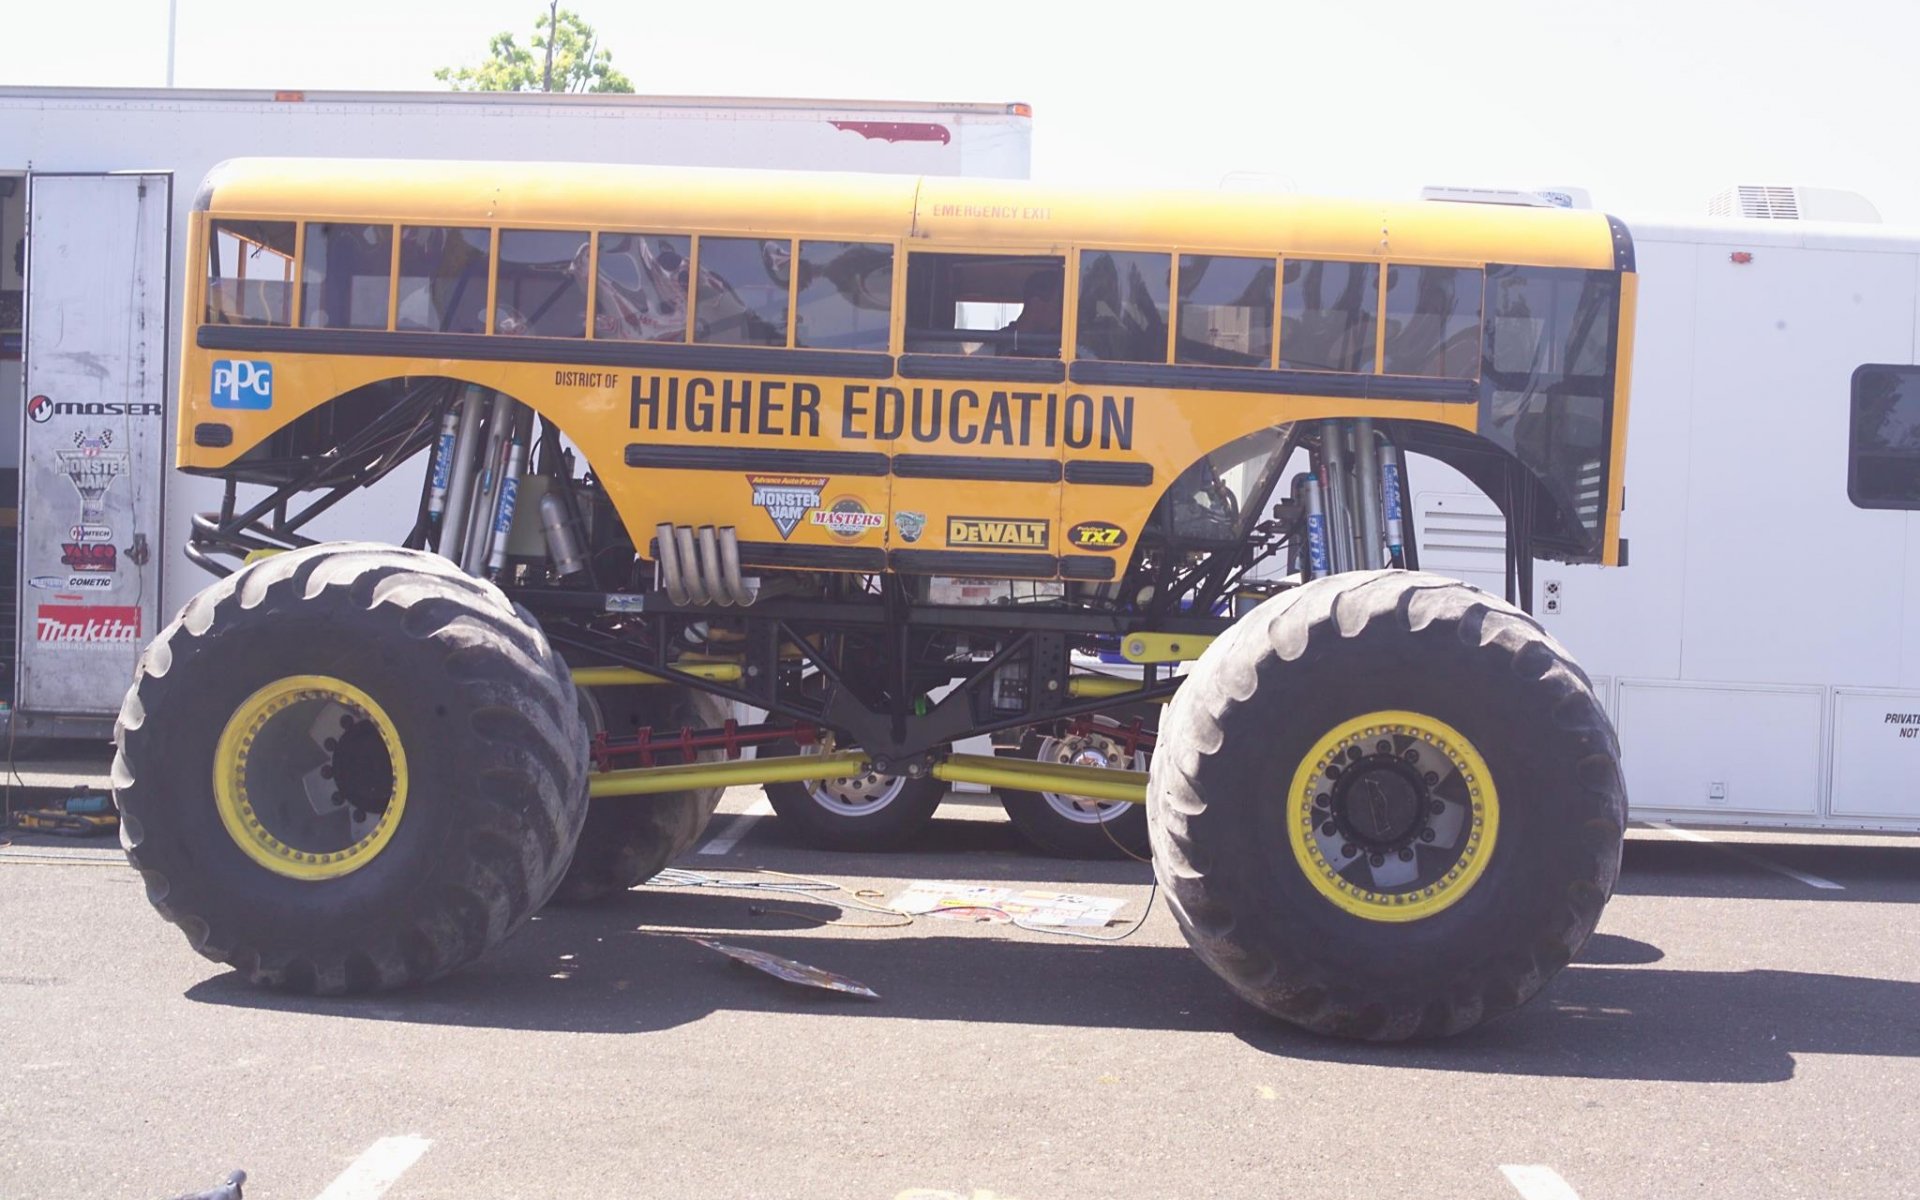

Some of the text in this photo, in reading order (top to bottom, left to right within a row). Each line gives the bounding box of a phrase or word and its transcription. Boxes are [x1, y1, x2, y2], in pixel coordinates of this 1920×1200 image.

[933, 205, 1054, 220] EMERGENCY EXIT
[214, 359, 270, 401] PPG
[555, 371, 618, 389] DISTRICT OF
[54, 402, 162, 416] MOSER
[629, 375, 1134, 451] HIGHER EDUCATION
[752, 492, 819, 507] MONSTER
[771, 507, 801, 520] JAM
[813, 512, 881, 526] MASTERS
[1080, 529, 1120, 543] TX7
[1308, 517, 1320, 568] KING
[69, 578, 111, 586] COMETIC
[1884, 713, 1920, 724] PRIVATE
[1899, 728, 1919, 738] NOT
